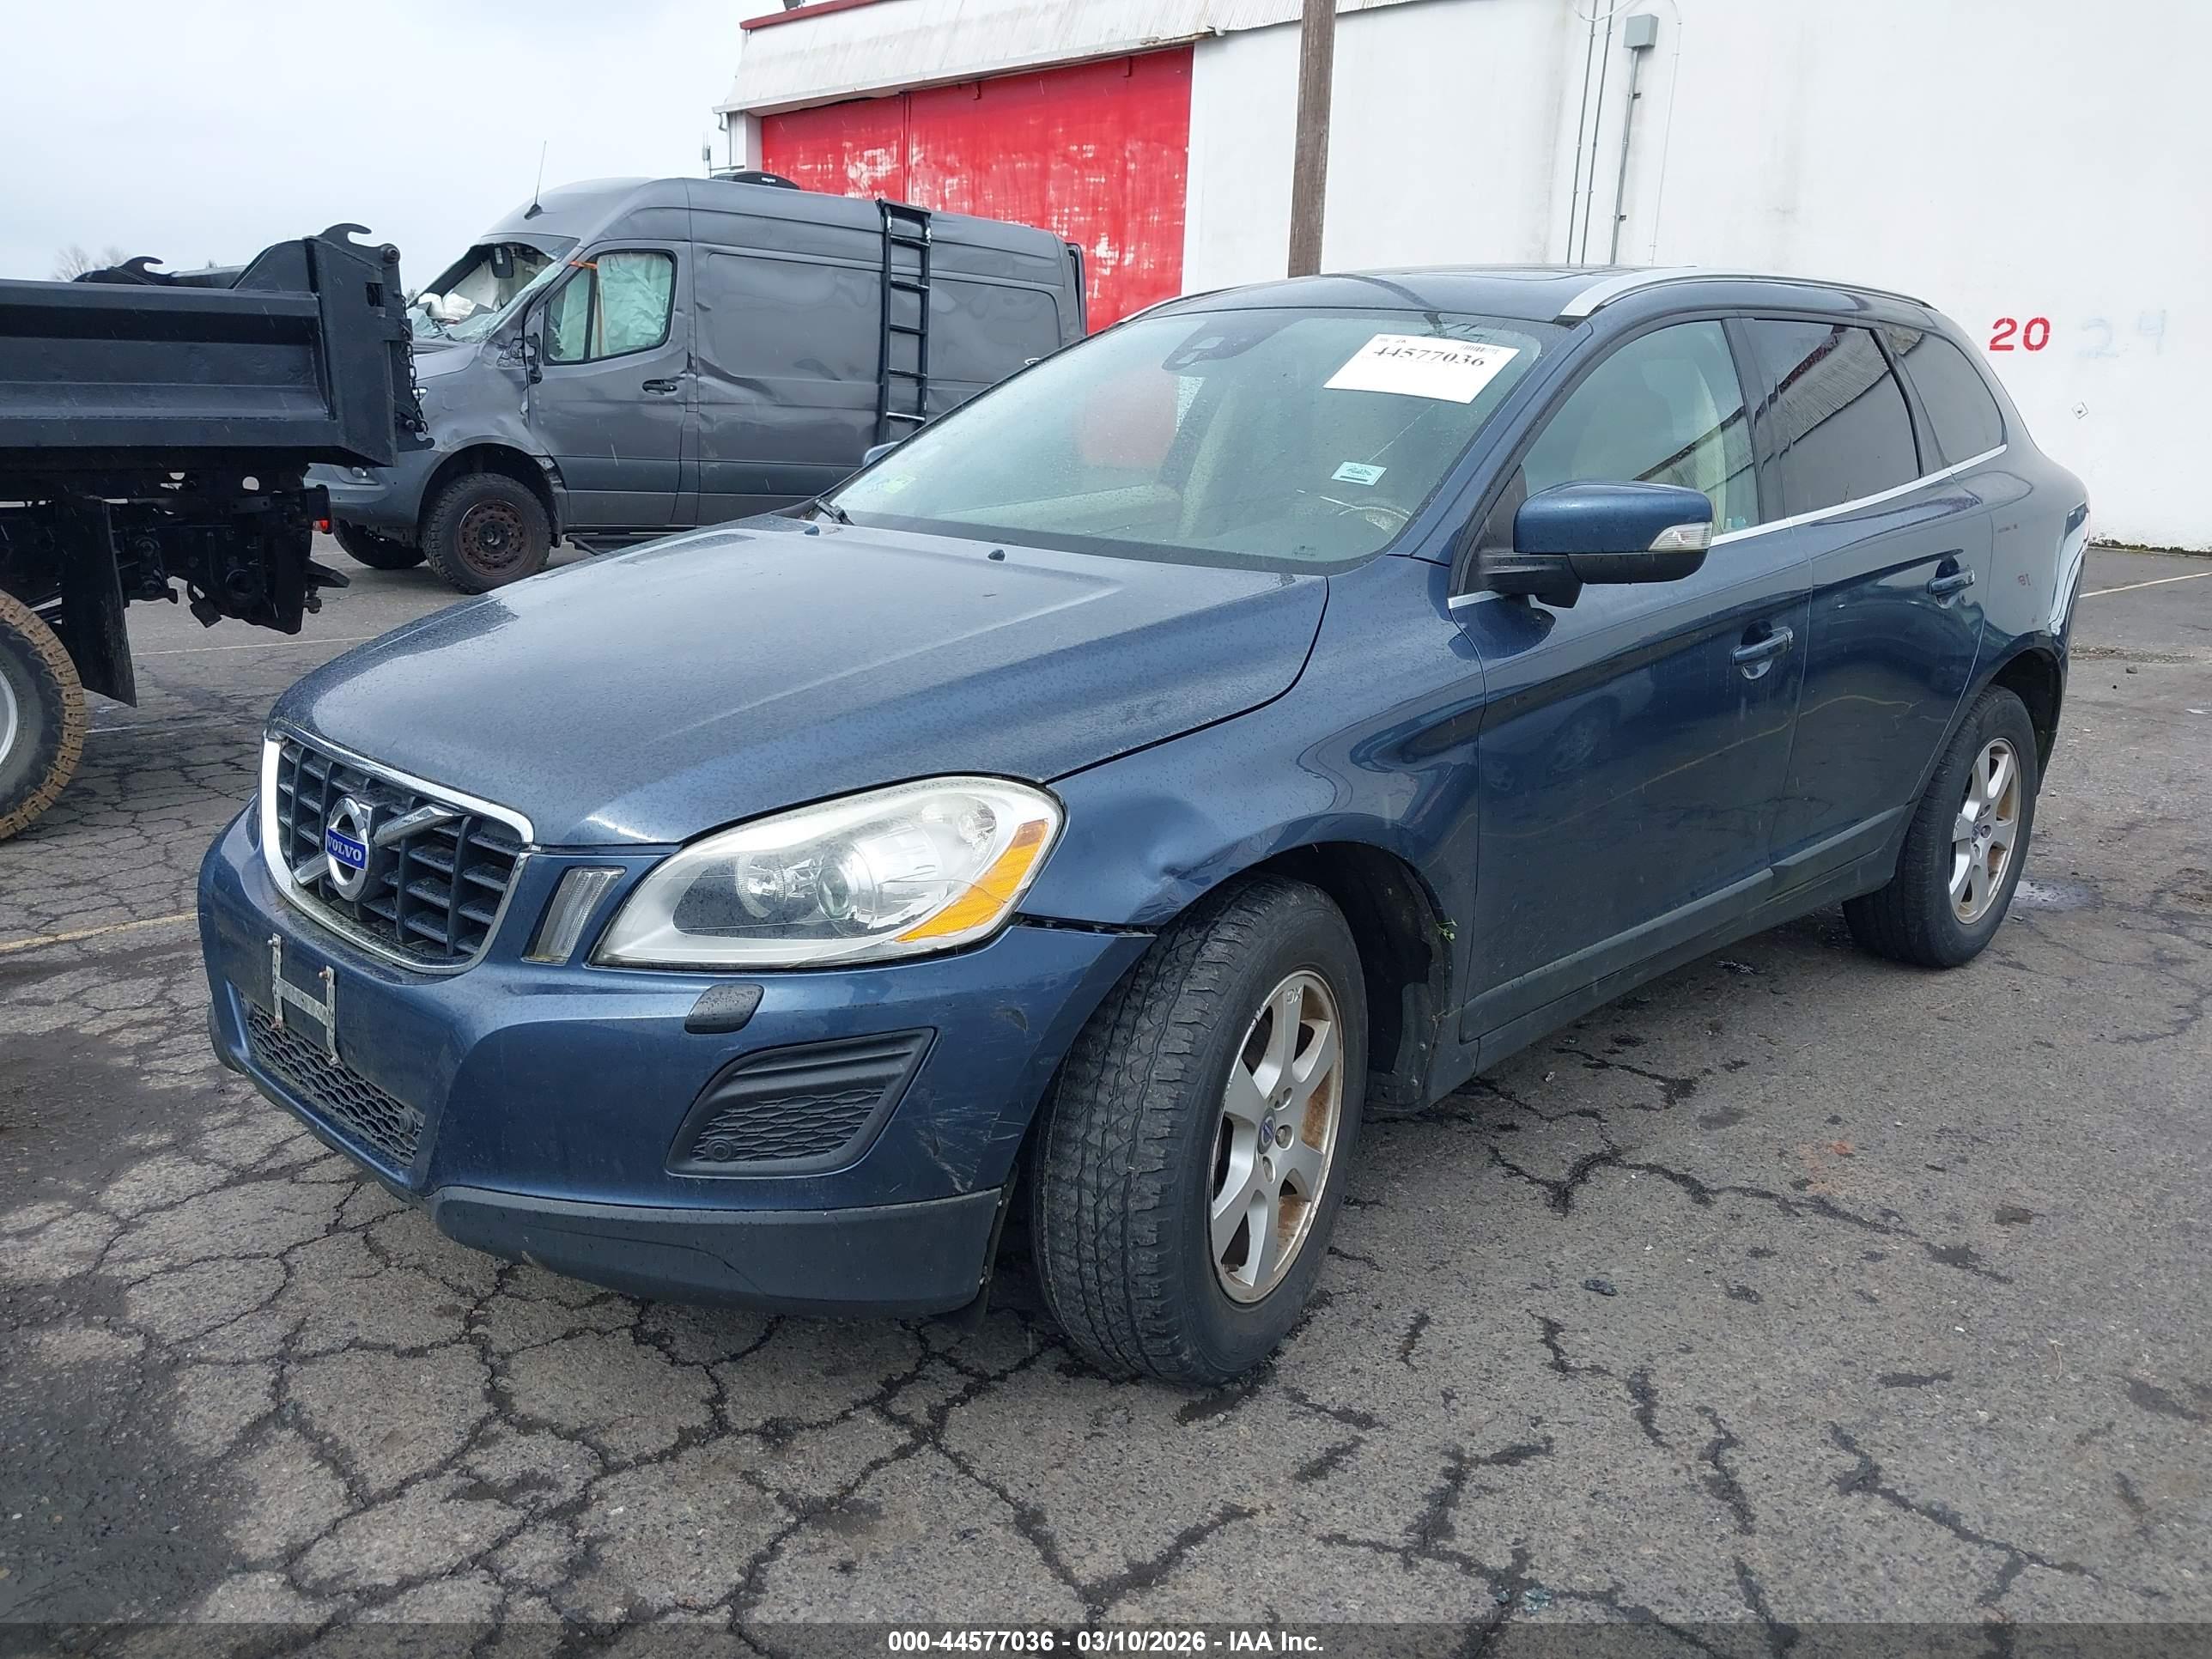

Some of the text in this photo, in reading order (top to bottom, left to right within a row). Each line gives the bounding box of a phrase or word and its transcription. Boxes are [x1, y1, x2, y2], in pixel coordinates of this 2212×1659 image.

[1989, 317, 2051, 351] 20
[1373, 346, 1485, 367] 44577036
[327, 836, 362, 861] VOLVO
